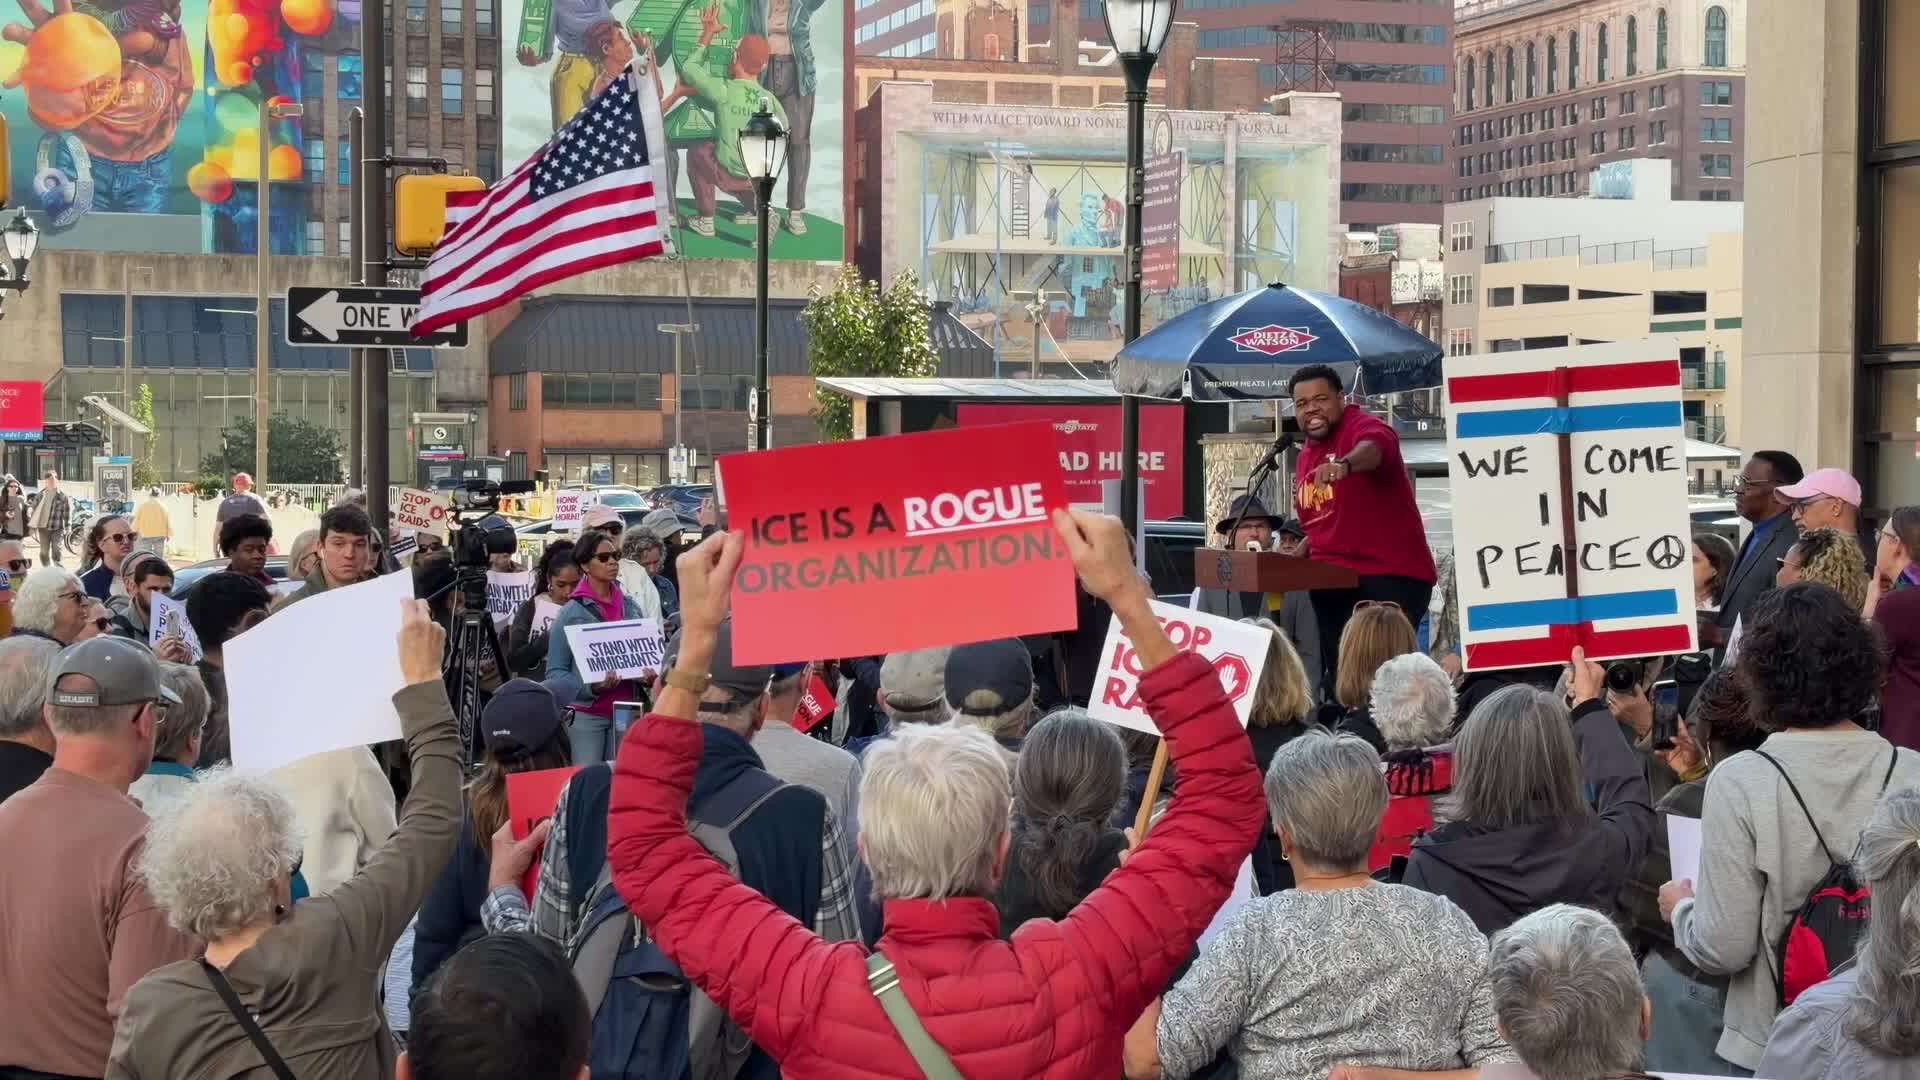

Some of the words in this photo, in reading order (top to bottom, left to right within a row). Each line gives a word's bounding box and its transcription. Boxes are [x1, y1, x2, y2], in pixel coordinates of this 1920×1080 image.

[934, 111, 968, 124] WITH
[973, 113, 1023, 126] MALICE
[1027, 114, 1081, 128] TOWARD
[1176, 119, 1223, 131] HARITY
[343, 306, 391, 328] ONE
[1244, 338, 1299, 346] WATSON
[1458, 446, 1529, 479] WE
[1584, 444, 1680, 475] COME
[400, 503, 417, 514] ICE
[402, 492, 431, 506] STOP
[399, 513, 430, 528] RAIDS
[752, 512, 809, 548] ICE
[820, 507, 855, 540] IS
[867, 502, 896, 535] A
[904, 483, 1047, 531] ROGUE
[1476, 536, 1641, 588] PEACE
[502, 585, 529, 600] WITH
[589, 639, 626, 658] STAND
[625, 636, 658, 654] WITH
[586, 651, 660, 672] IMMIGRANTS
[1110, 640, 1144, 678] IC
